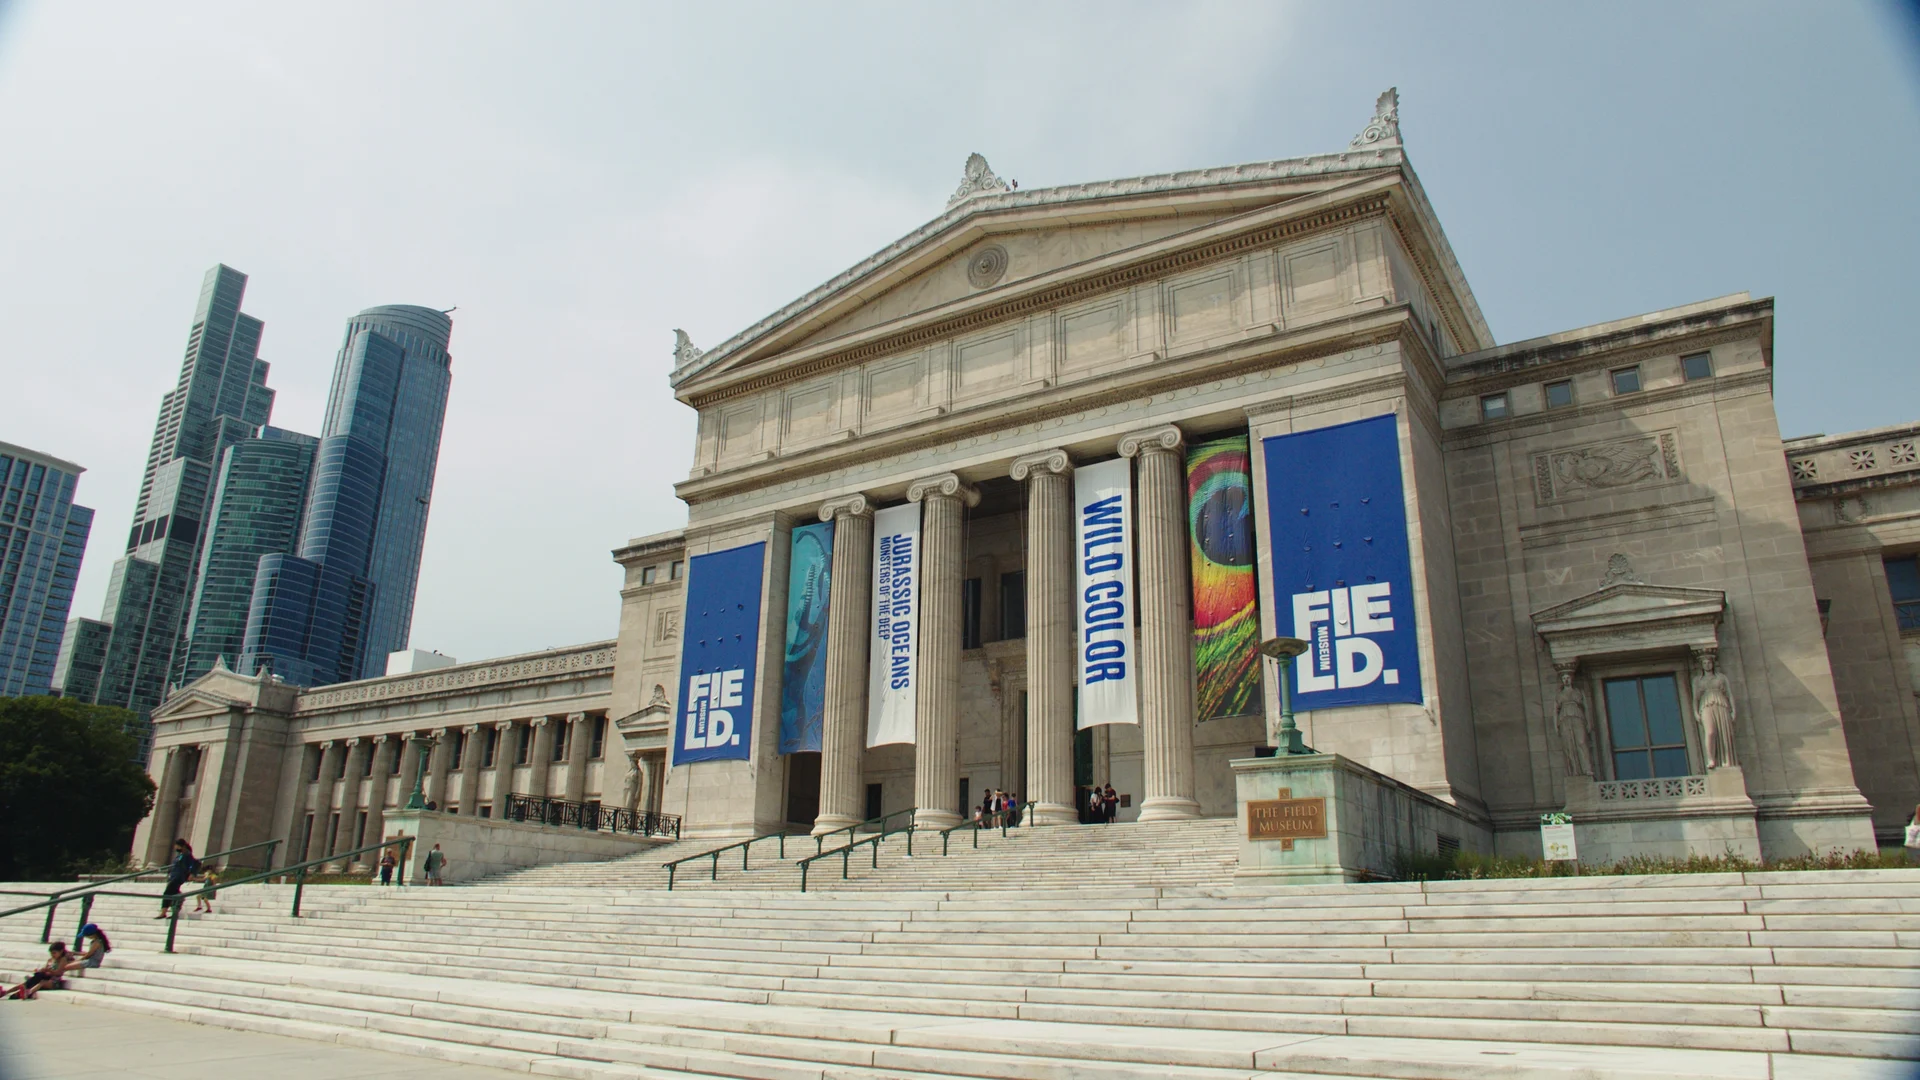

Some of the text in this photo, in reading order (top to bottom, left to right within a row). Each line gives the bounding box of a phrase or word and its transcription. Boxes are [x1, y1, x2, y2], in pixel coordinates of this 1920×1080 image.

[878, 536, 891, 640] MONSTERS OF THE DEEP
[1083, 494, 1126, 685] WILD COLOR
[891, 534, 912, 690] JURASSIC OCEANS
[1317, 626, 1331, 671] MUSEUM
[698, 700, 707, 734] MUSEUM
[1255, 805, 1318, 819] THE FIELD
[1260, 820, 1313, 832] MUSEUM
